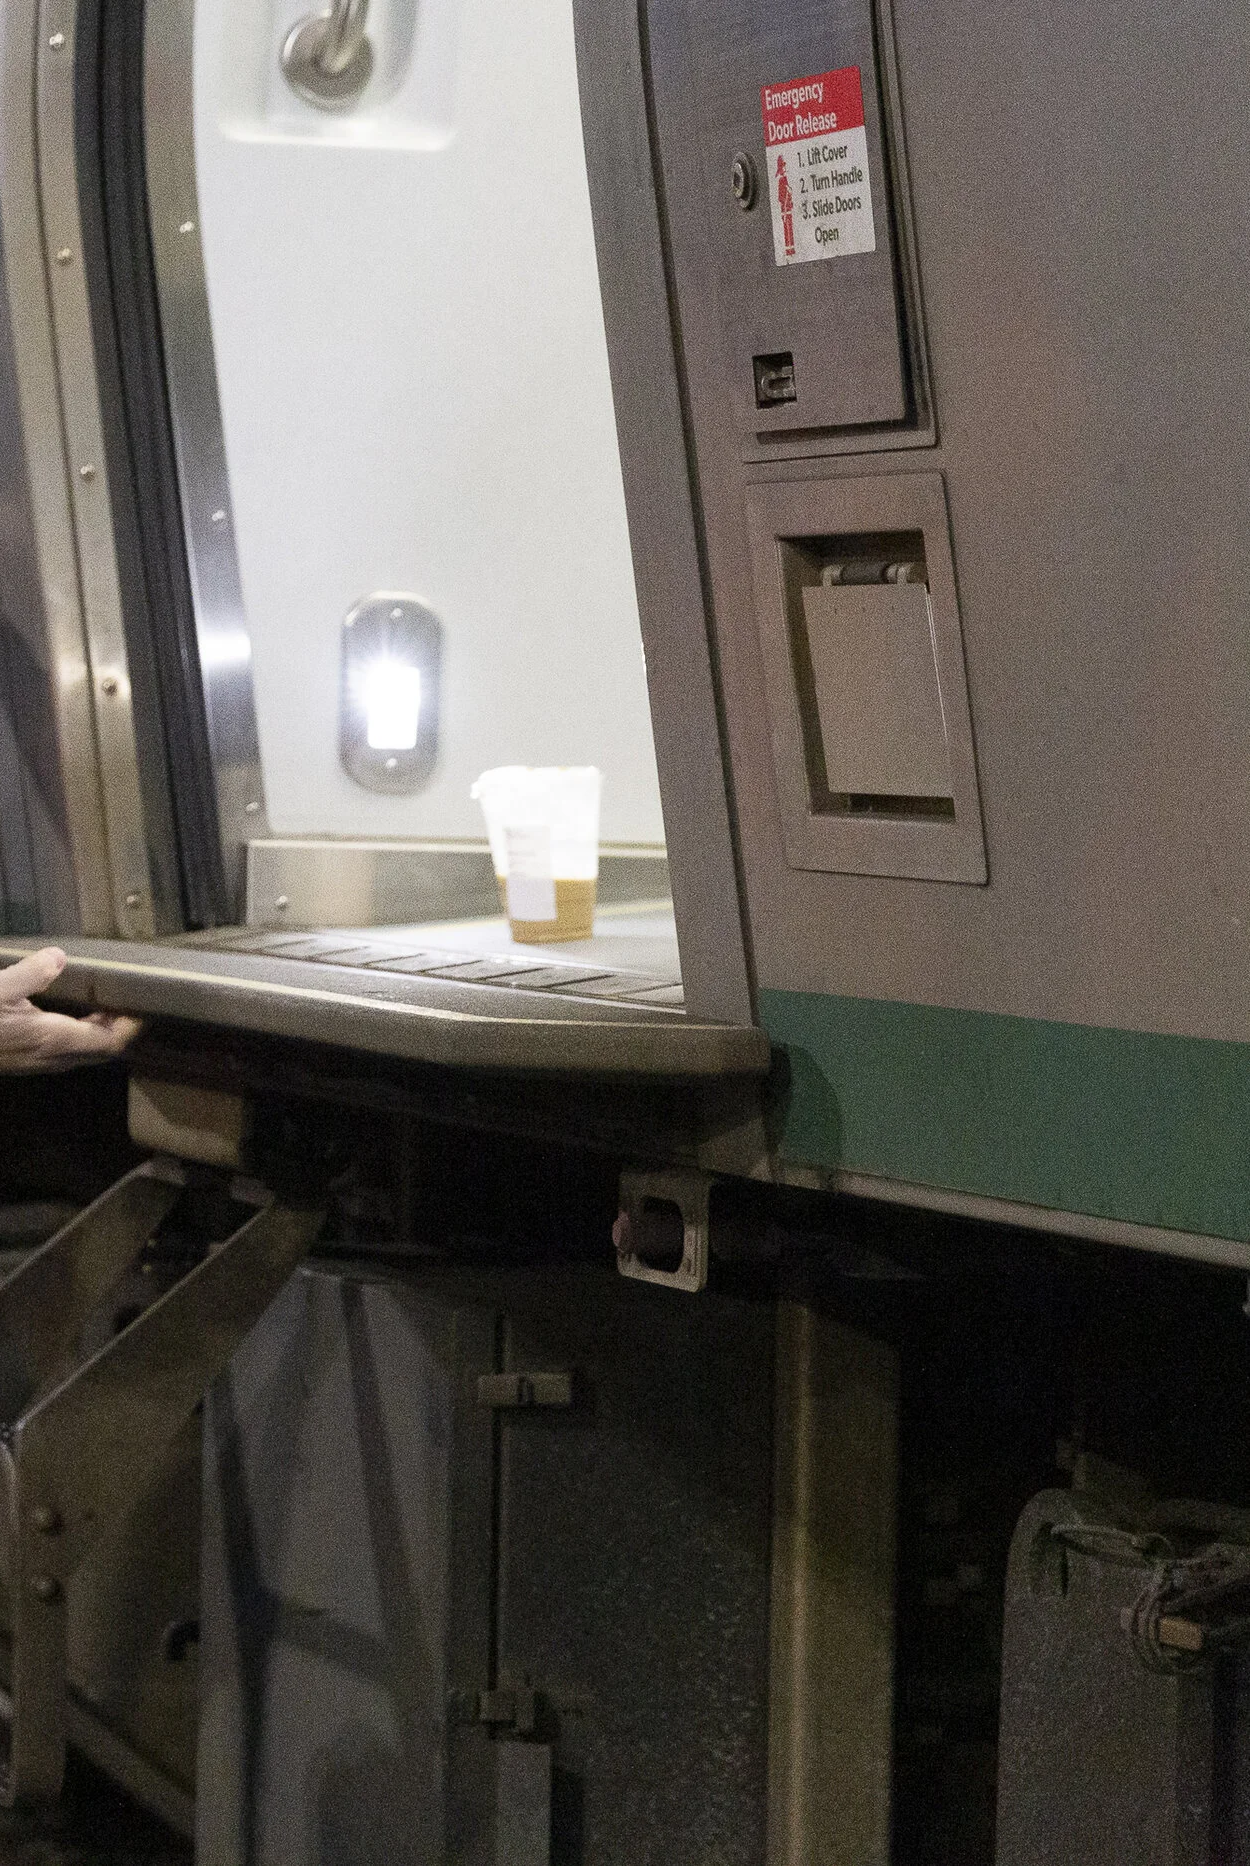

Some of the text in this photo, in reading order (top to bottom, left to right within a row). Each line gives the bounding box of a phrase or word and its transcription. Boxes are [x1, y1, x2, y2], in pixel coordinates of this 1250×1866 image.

[764, 82, 824, 111] Emergency
[767, 111, 837, 142] Door Release
[797, 145, 848, 167] 1. Lift Cover
[799, 166, 863, 194] 2. Turn Handle
[801, 196, 862, 220] 3. Slide Doors
[815, 227, 839, 246] Open
